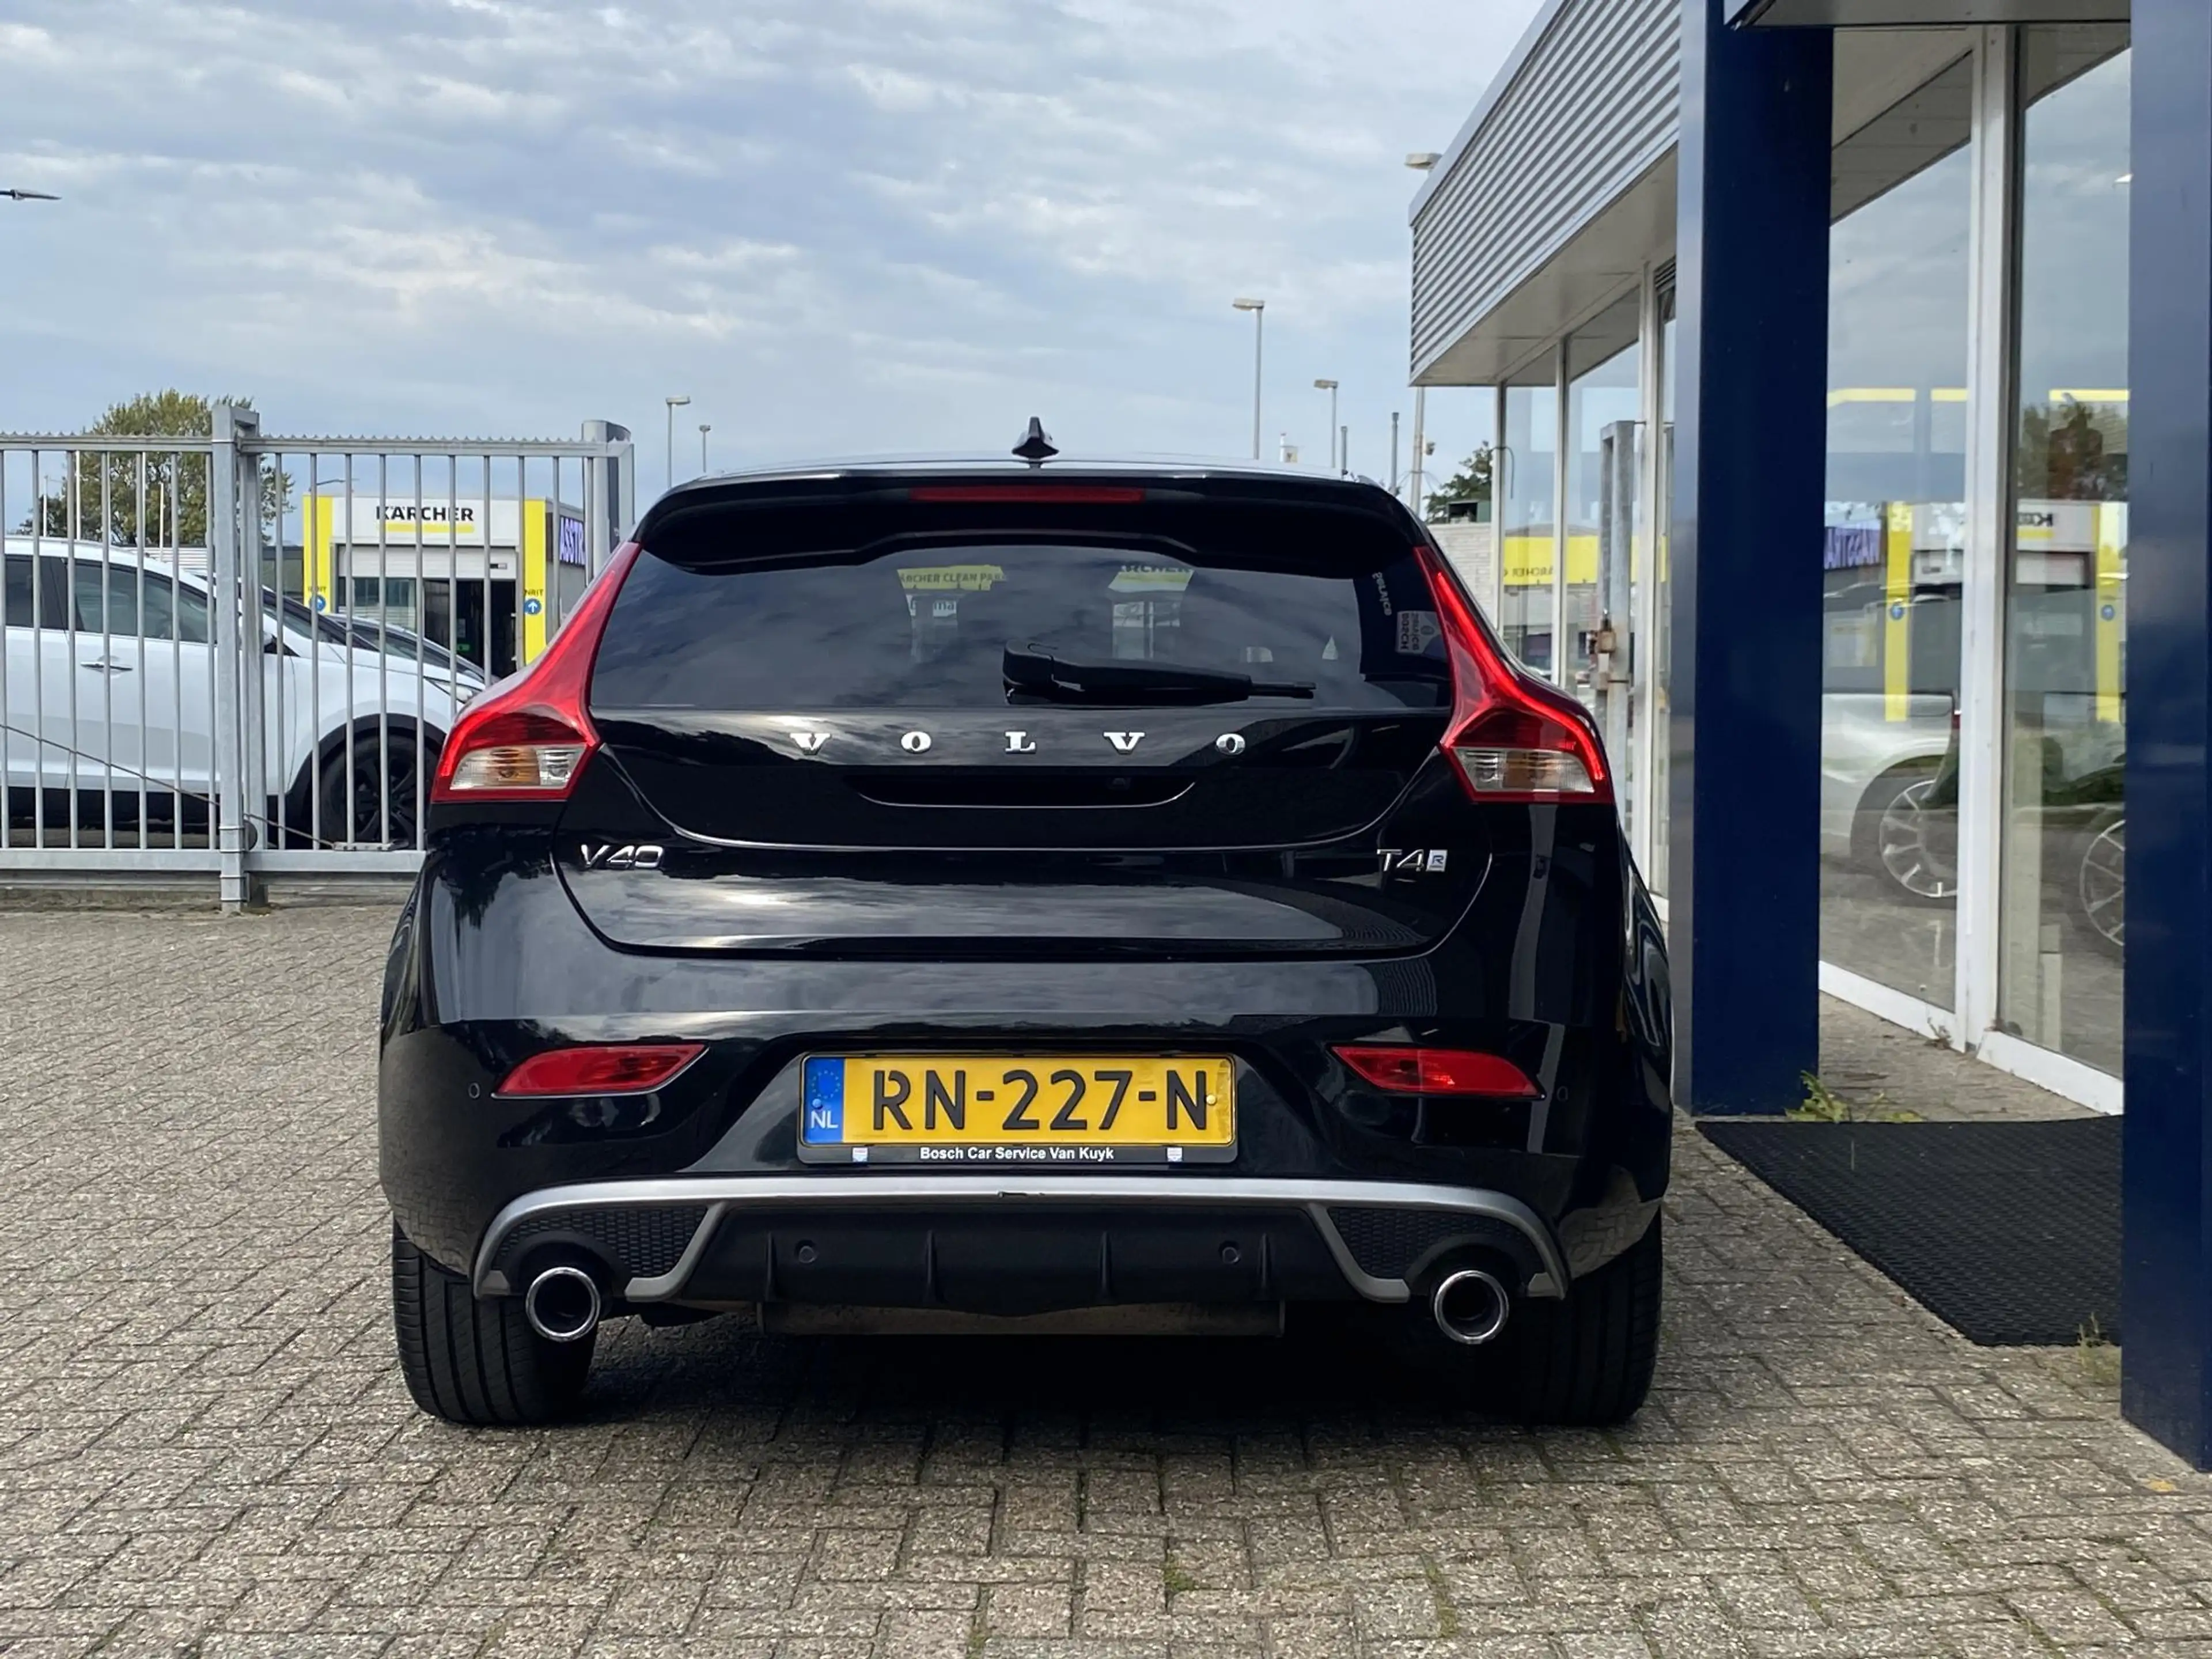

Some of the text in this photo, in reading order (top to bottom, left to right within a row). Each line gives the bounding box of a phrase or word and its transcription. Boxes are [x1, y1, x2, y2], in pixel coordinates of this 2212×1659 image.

[790, 732, 1245, 755] VOLVO
[581, 844, 664, 868] V40
[873, 1070, 1207, 1130] RN-227-N
[810, 1111, 839, 1129] NL
[920, 1147, 1115, 1162] Bosch Car Service Van Kuyk
